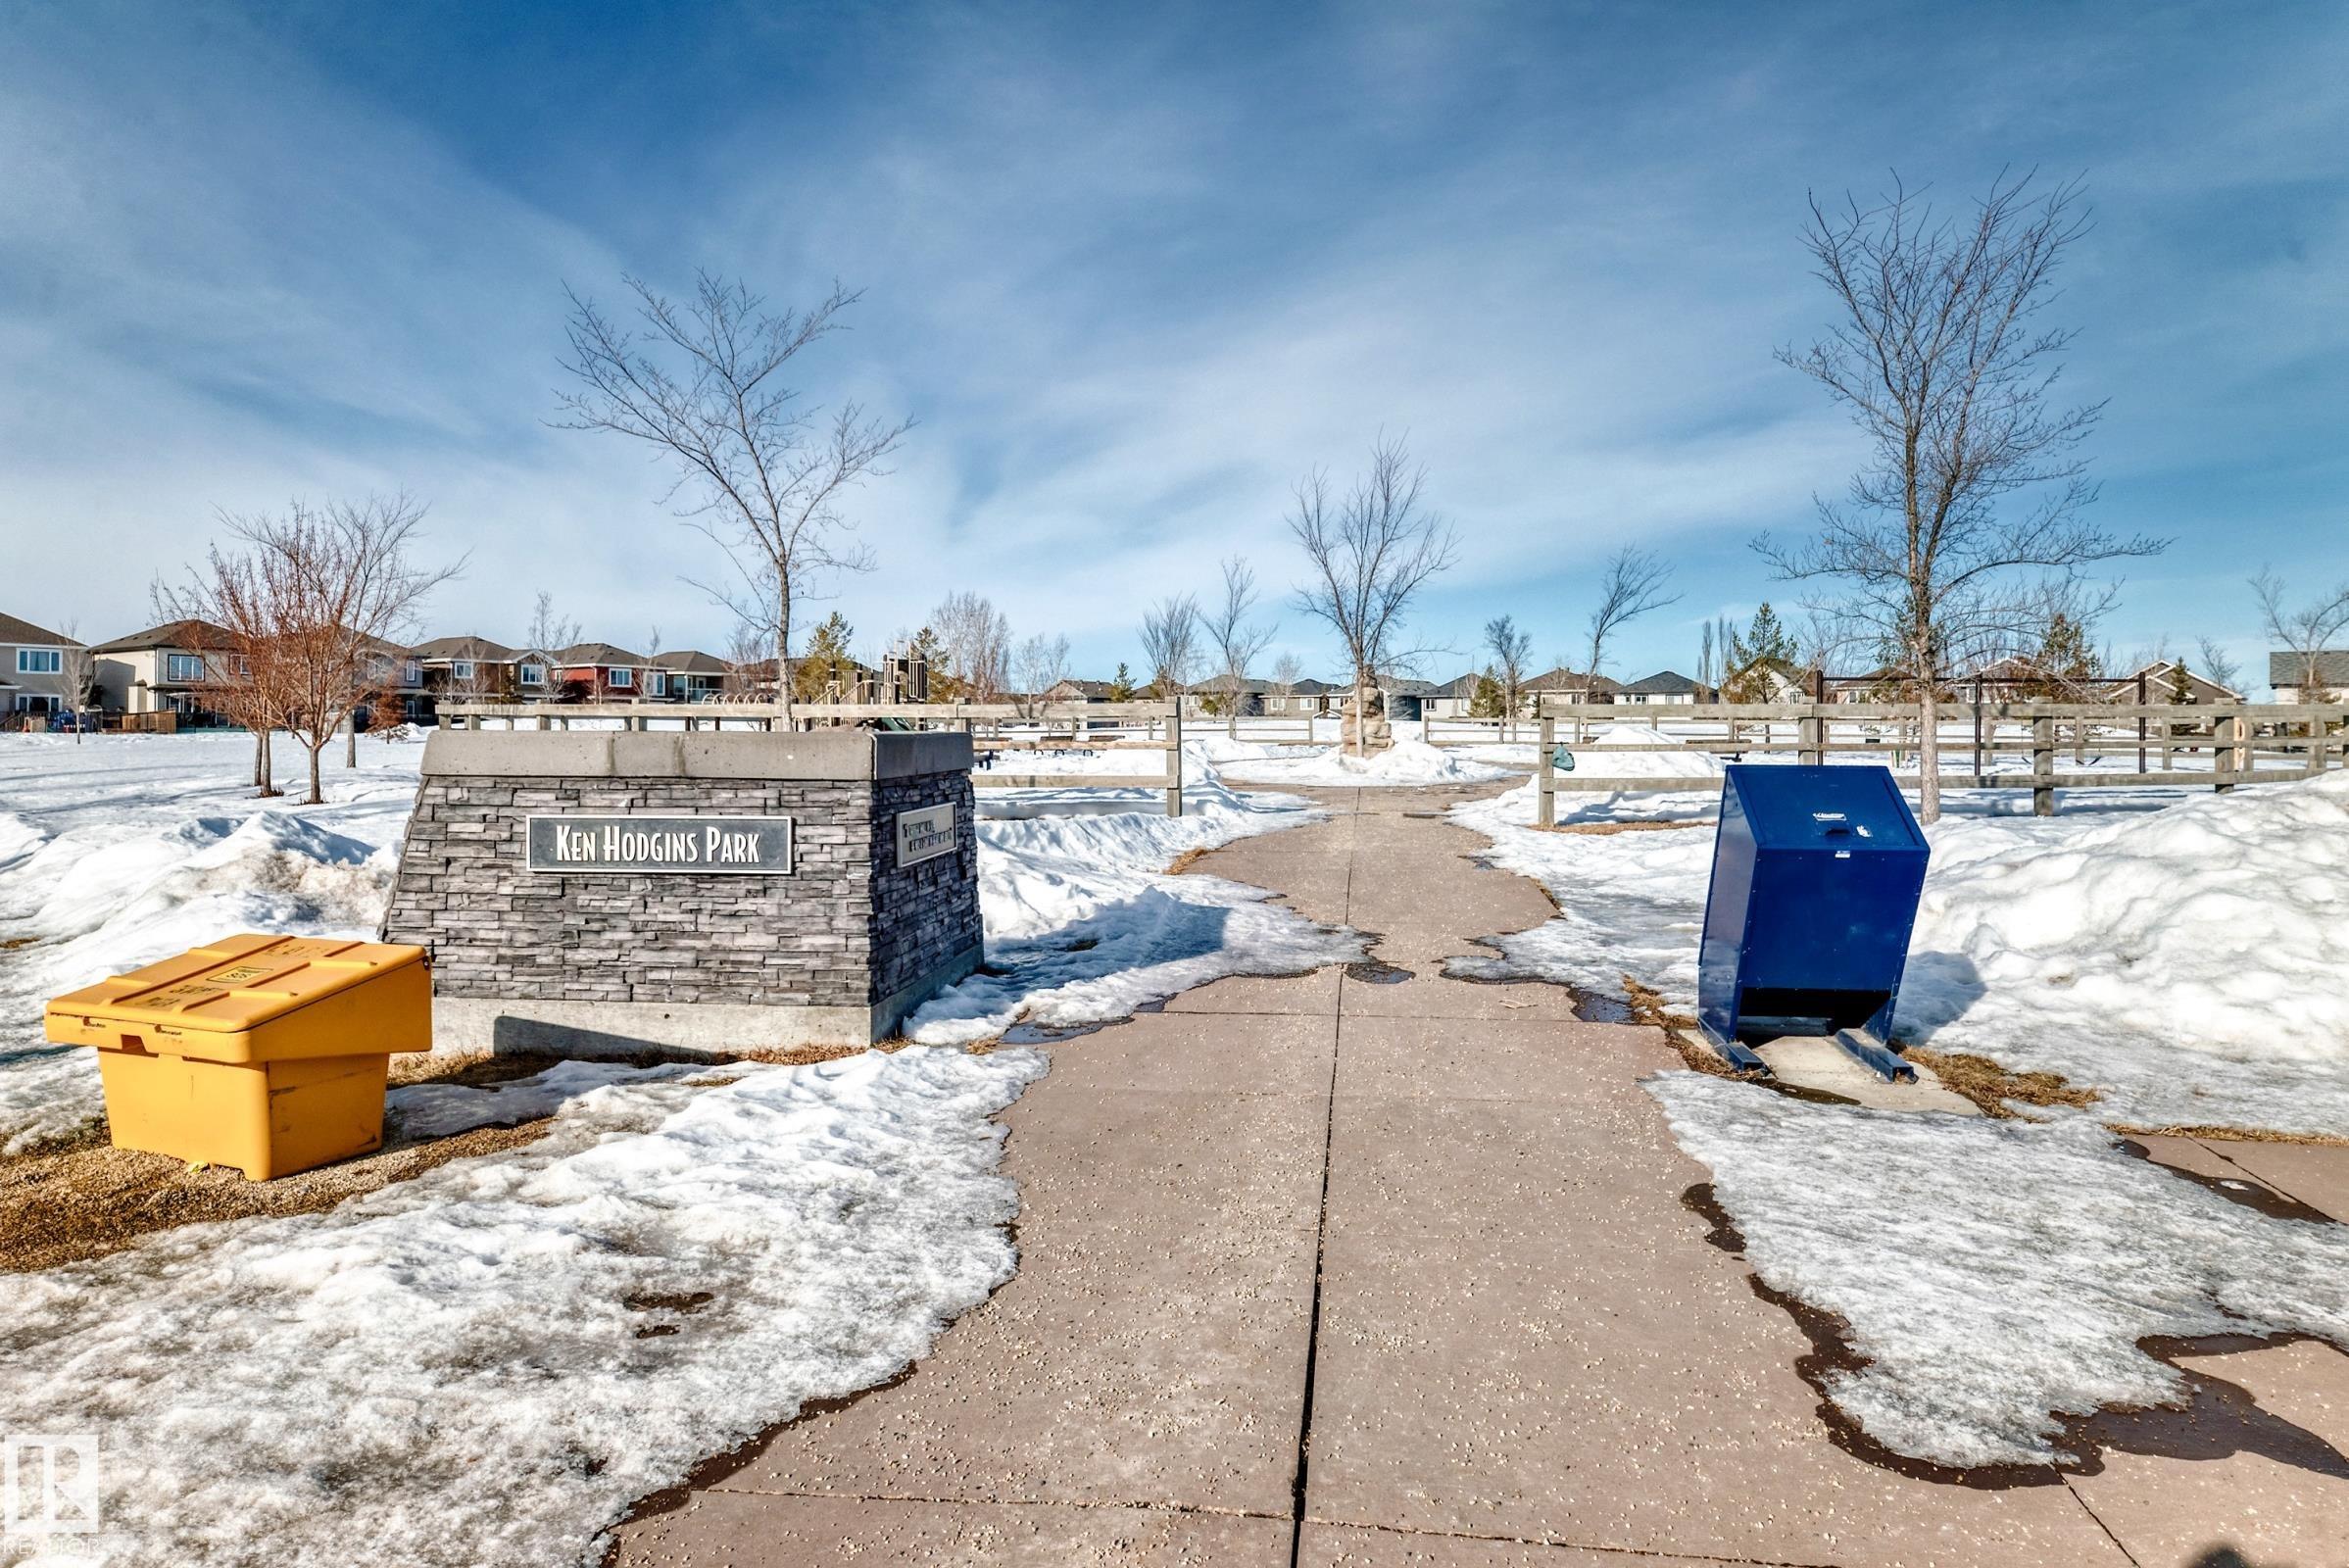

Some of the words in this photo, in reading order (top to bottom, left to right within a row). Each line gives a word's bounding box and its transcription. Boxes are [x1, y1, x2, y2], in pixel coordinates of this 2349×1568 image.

[556, 825, 597, 861] KEN
[603, 825, 699, 862] HODGINS
[706, 826, 760, 863] PARK
